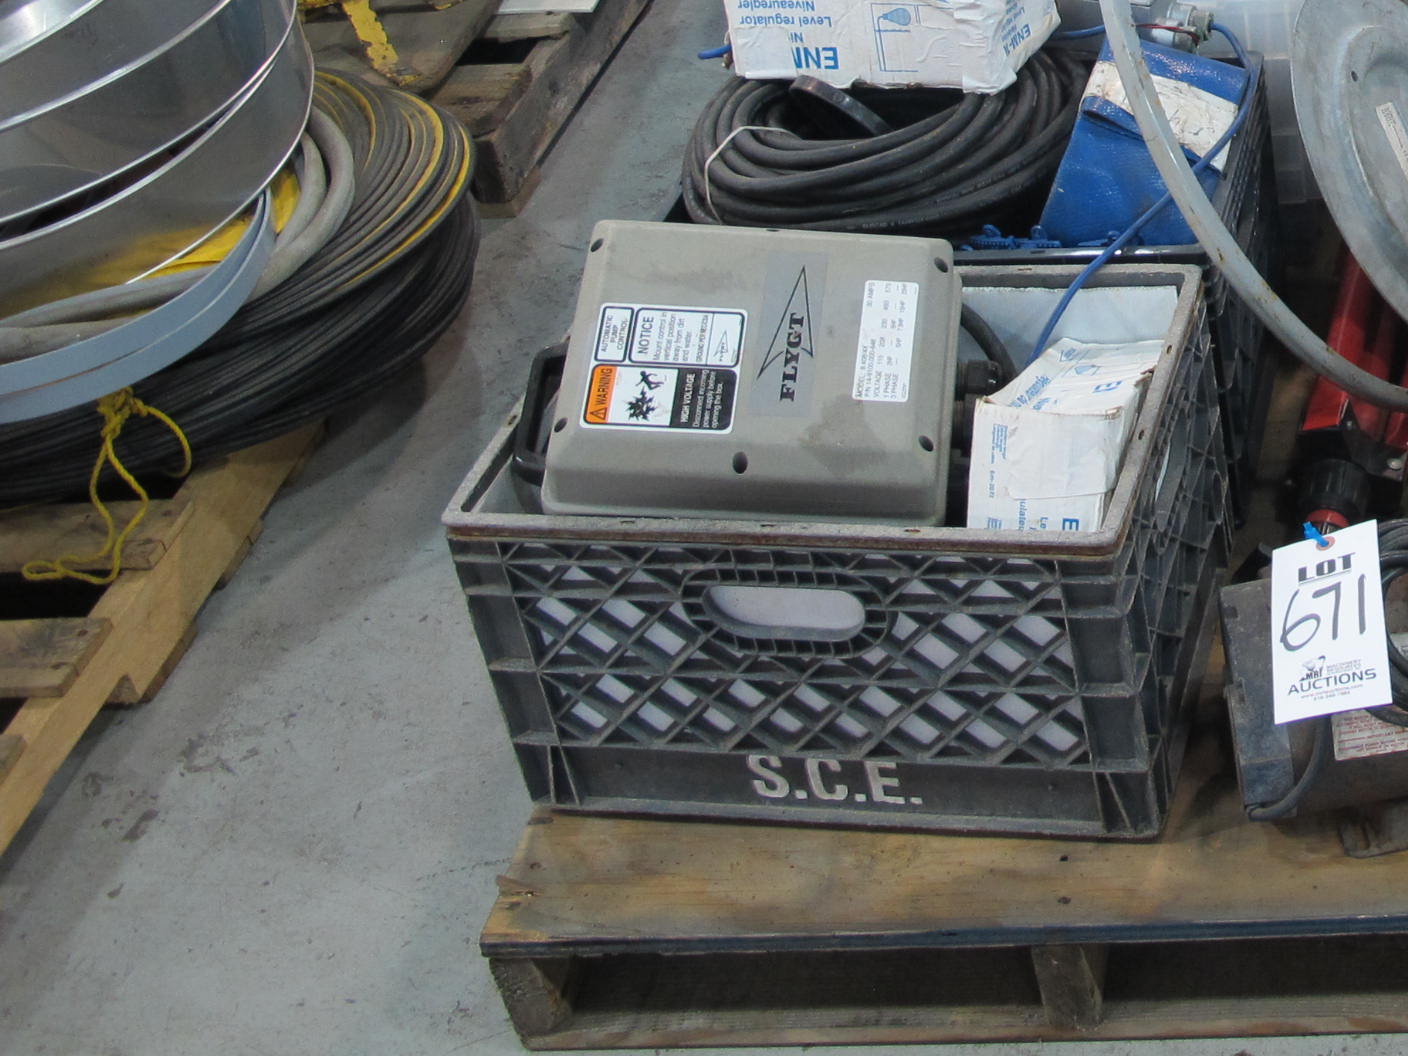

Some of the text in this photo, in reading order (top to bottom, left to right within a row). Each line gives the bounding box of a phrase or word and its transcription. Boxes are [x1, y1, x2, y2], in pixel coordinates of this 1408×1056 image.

[738, 0, 816, 12] Niveauregler
[740, 14, 832, 28] Level regulator
[601, 314, 613, 352] AUTOMATIC
[610, 324, 618, 344] PUMP
[617, 318, 628, 350] CONTROL
[637, 316, 654, 354] NOTICE
[653, 340, 664, 360] Mount
[780, 312, 804, 402] FLYGT
[596, 368, 613, 406] WARNING
[680, 373, 696, 422] HIGH VOLTAGE
[1298, 552, 1356, 582] LOT
[1280, 574, 1366, 652] 671
[1288, 668, 1377, 696] AUCTIONS
[746, 754, 923, 805] S.C.E.
